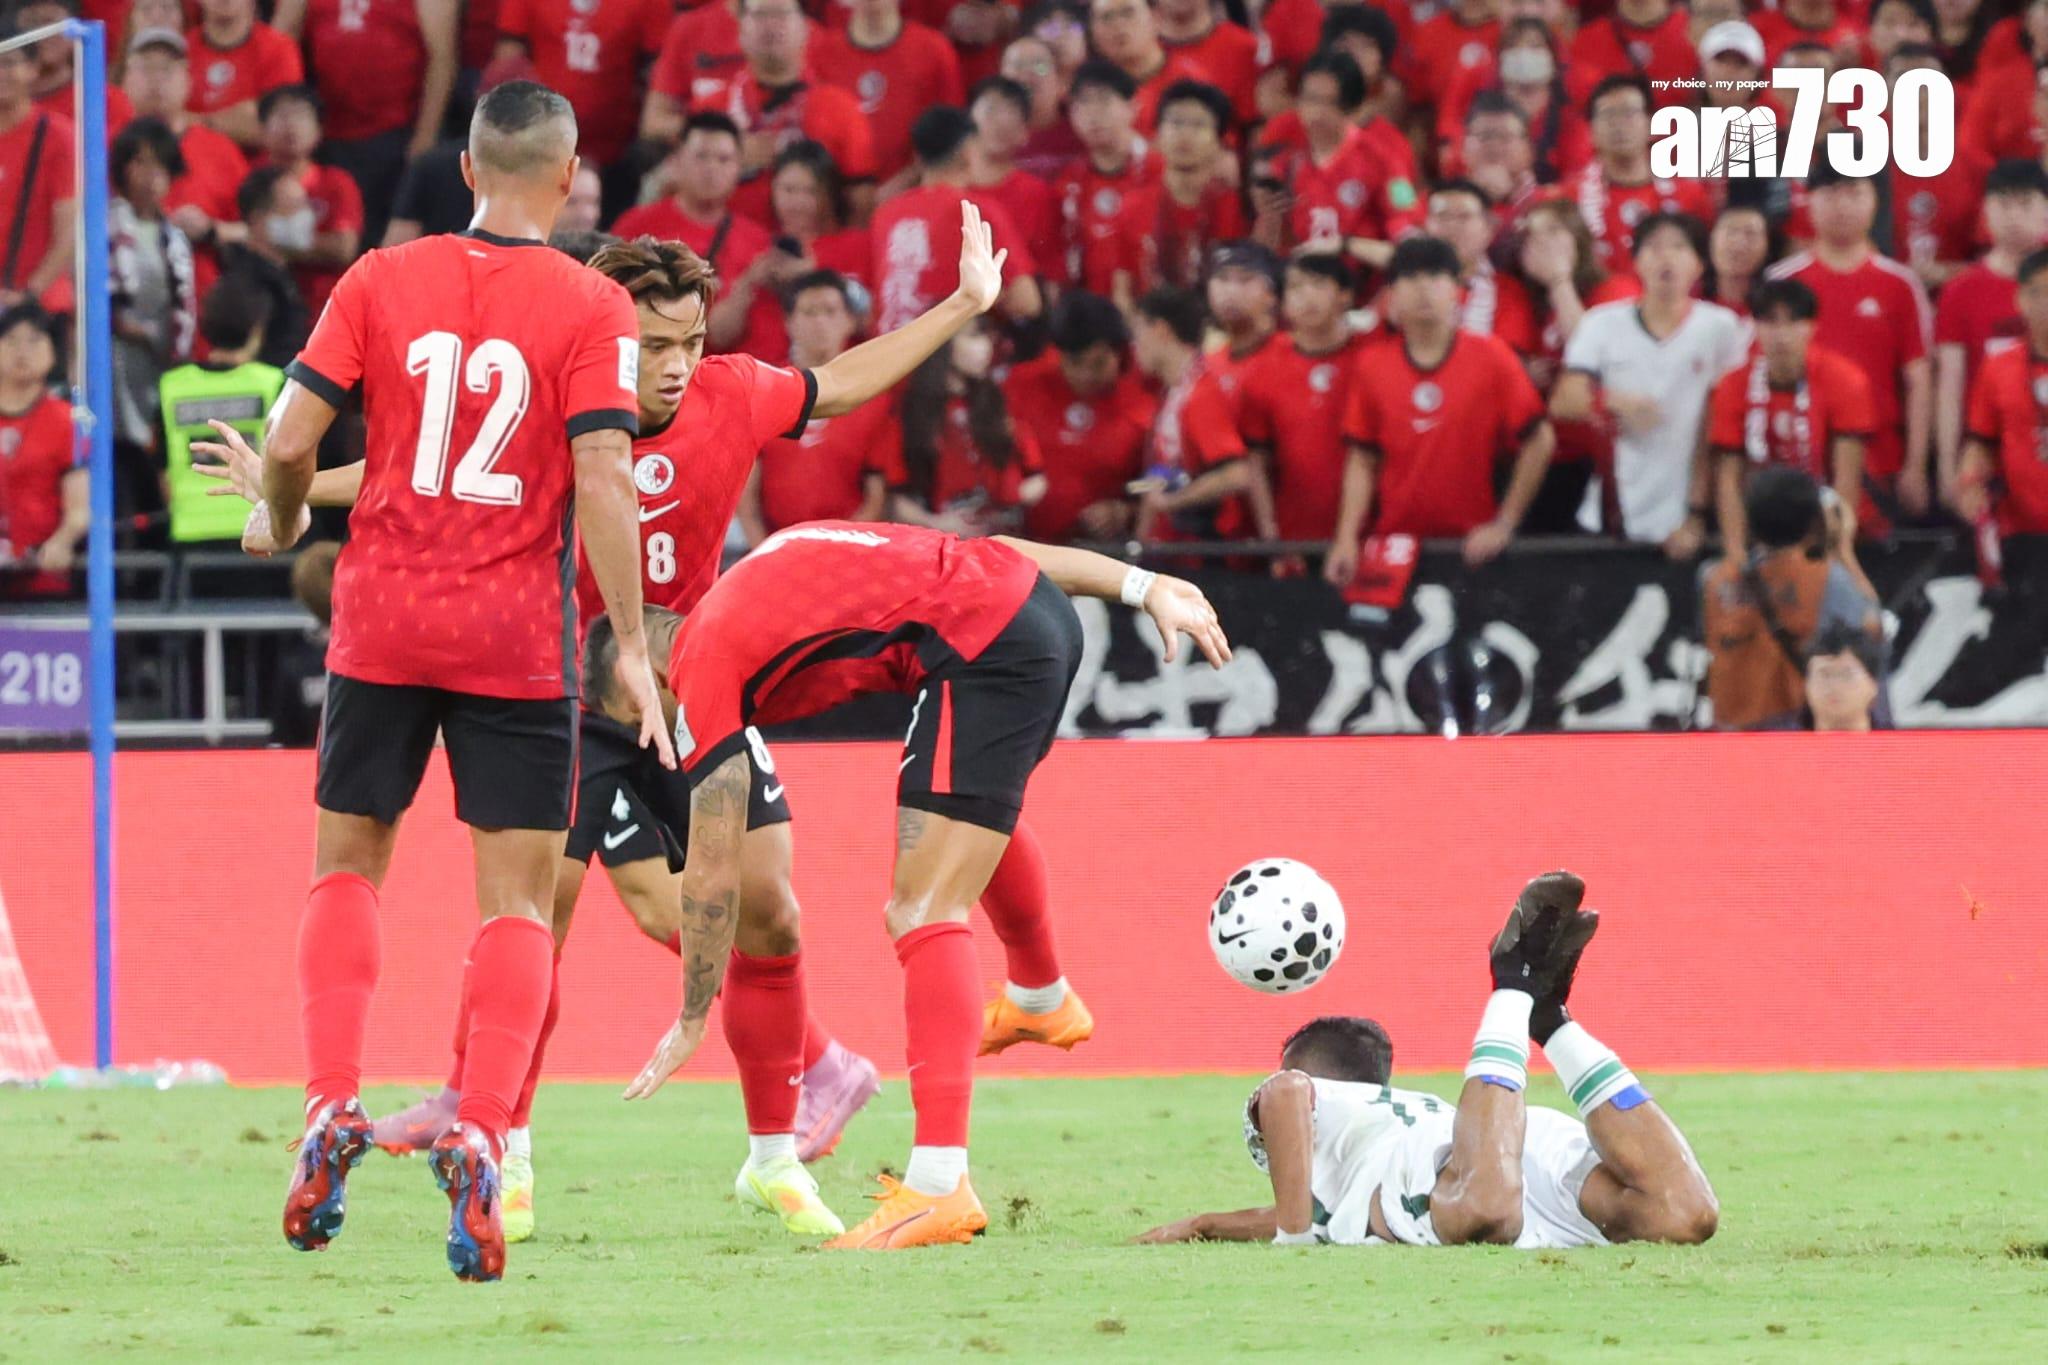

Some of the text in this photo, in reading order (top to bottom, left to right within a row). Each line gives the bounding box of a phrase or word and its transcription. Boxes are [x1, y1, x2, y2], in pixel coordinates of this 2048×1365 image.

[406, 330, 531, 506] 12
[646, 531, 676, 584] 8
[0, 651, 82, 707] 218
